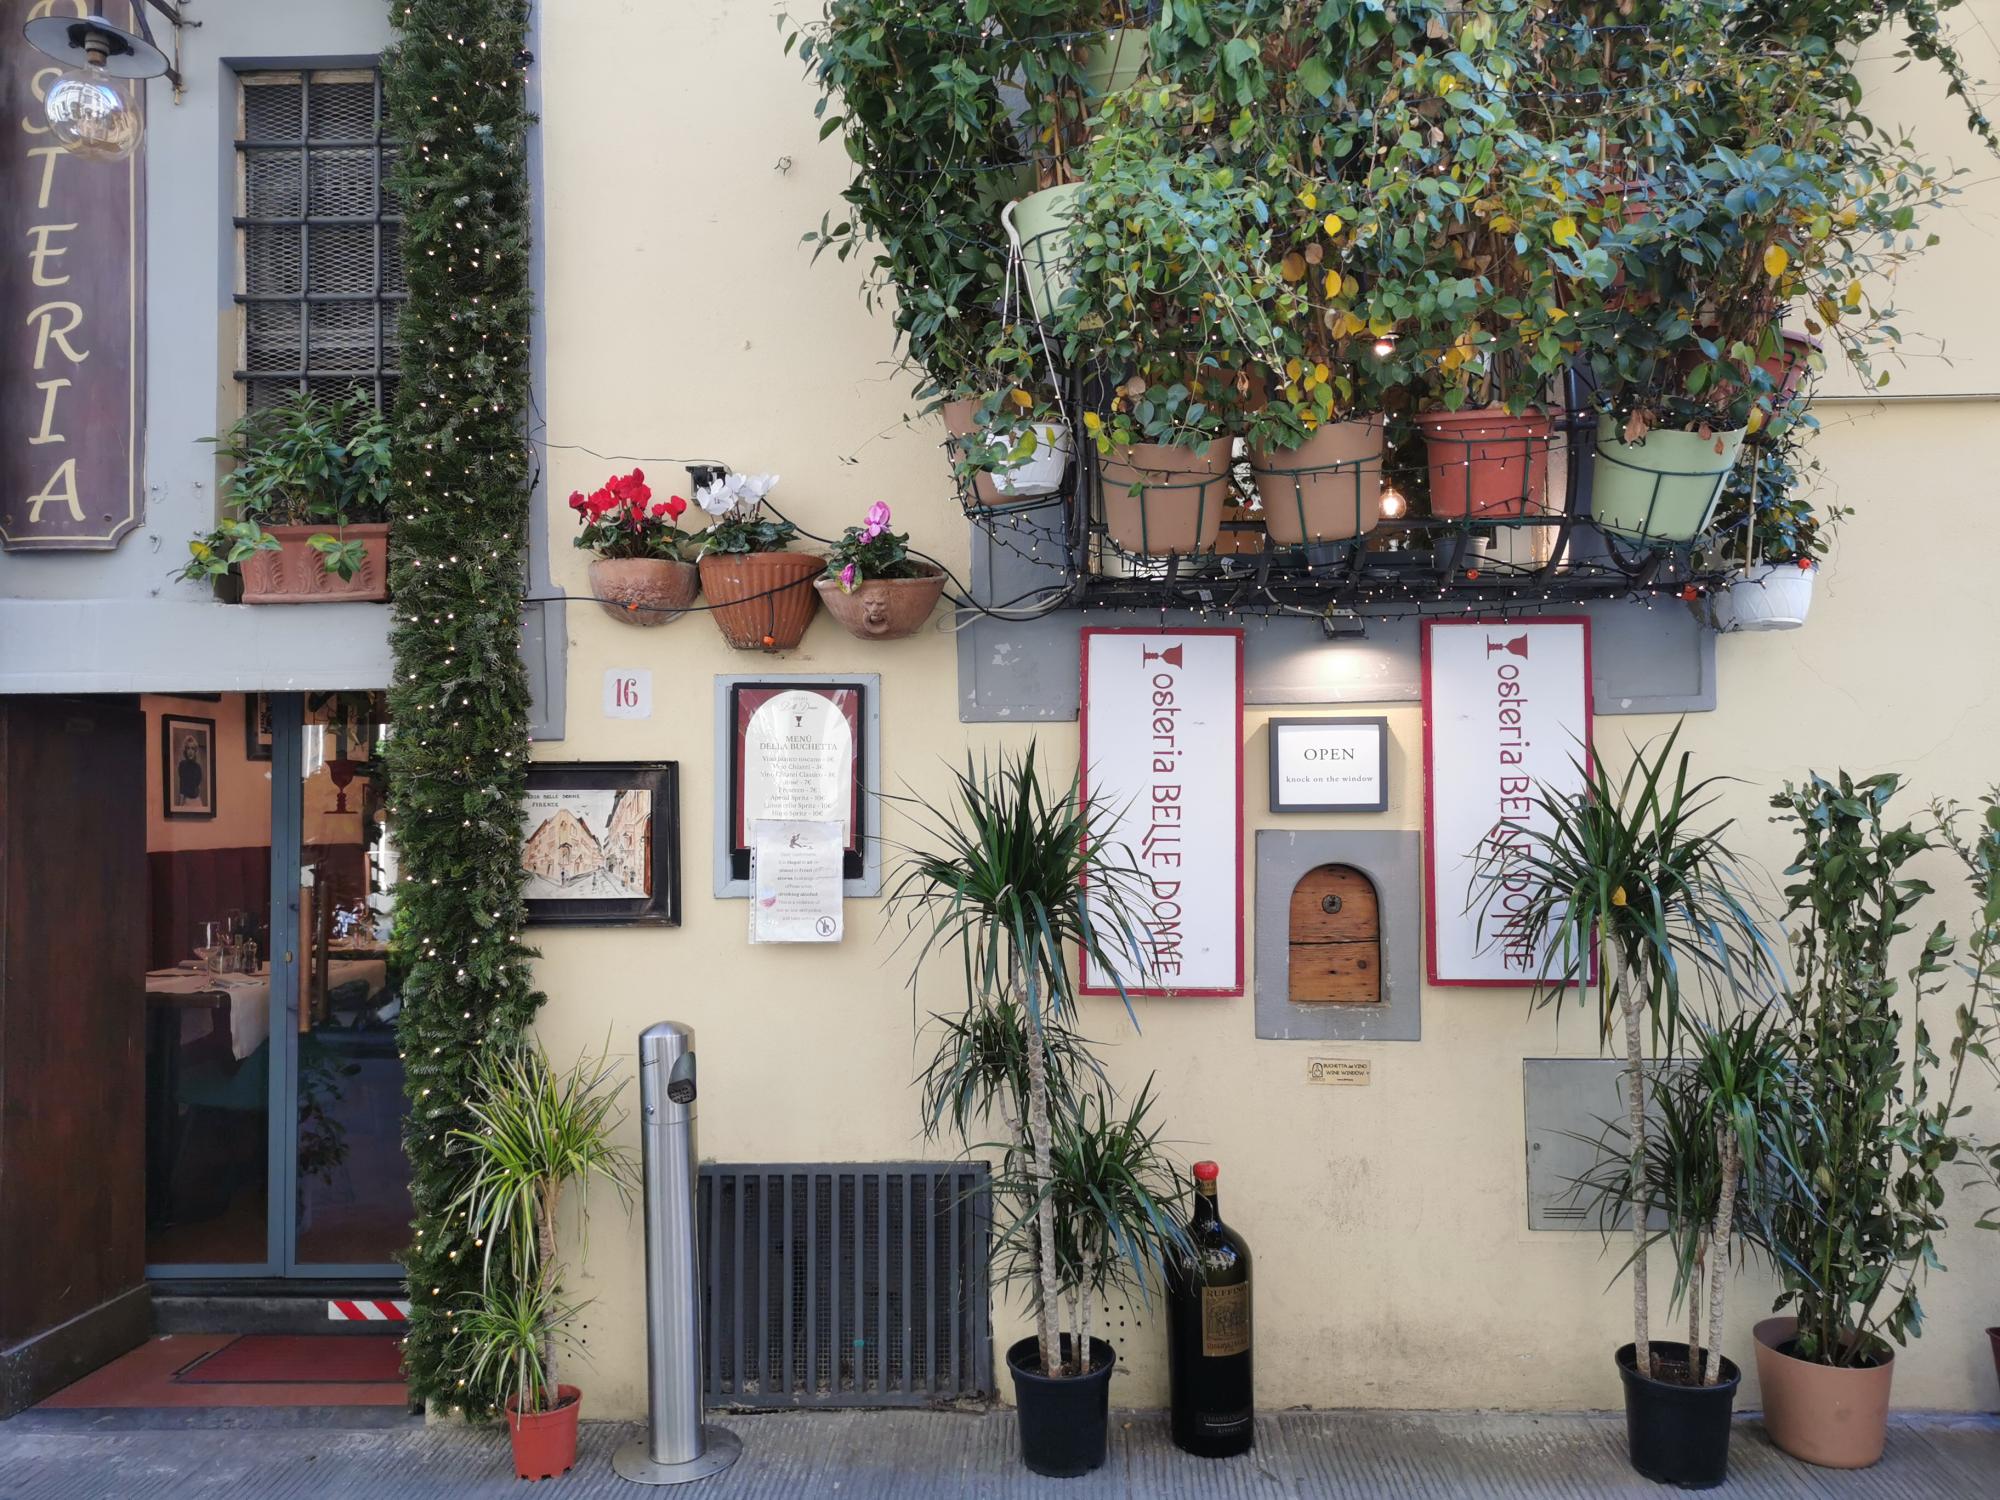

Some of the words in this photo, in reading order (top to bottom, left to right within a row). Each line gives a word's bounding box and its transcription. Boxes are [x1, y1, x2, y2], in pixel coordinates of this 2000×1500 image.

[22, 0, 90, 523] STERIA
[616, 678, 638, 707] 16
[1151, 673, 1182, 773] osteria
[1497, 664, 1530, 765] osteria
[790, 743, 838, 751] BUCHETTA
[1304, 748, 1354, 760] OPEN
[1141, 784, 1182, 868] BELLE
[1142, 880, 1184, 977] DONNE
